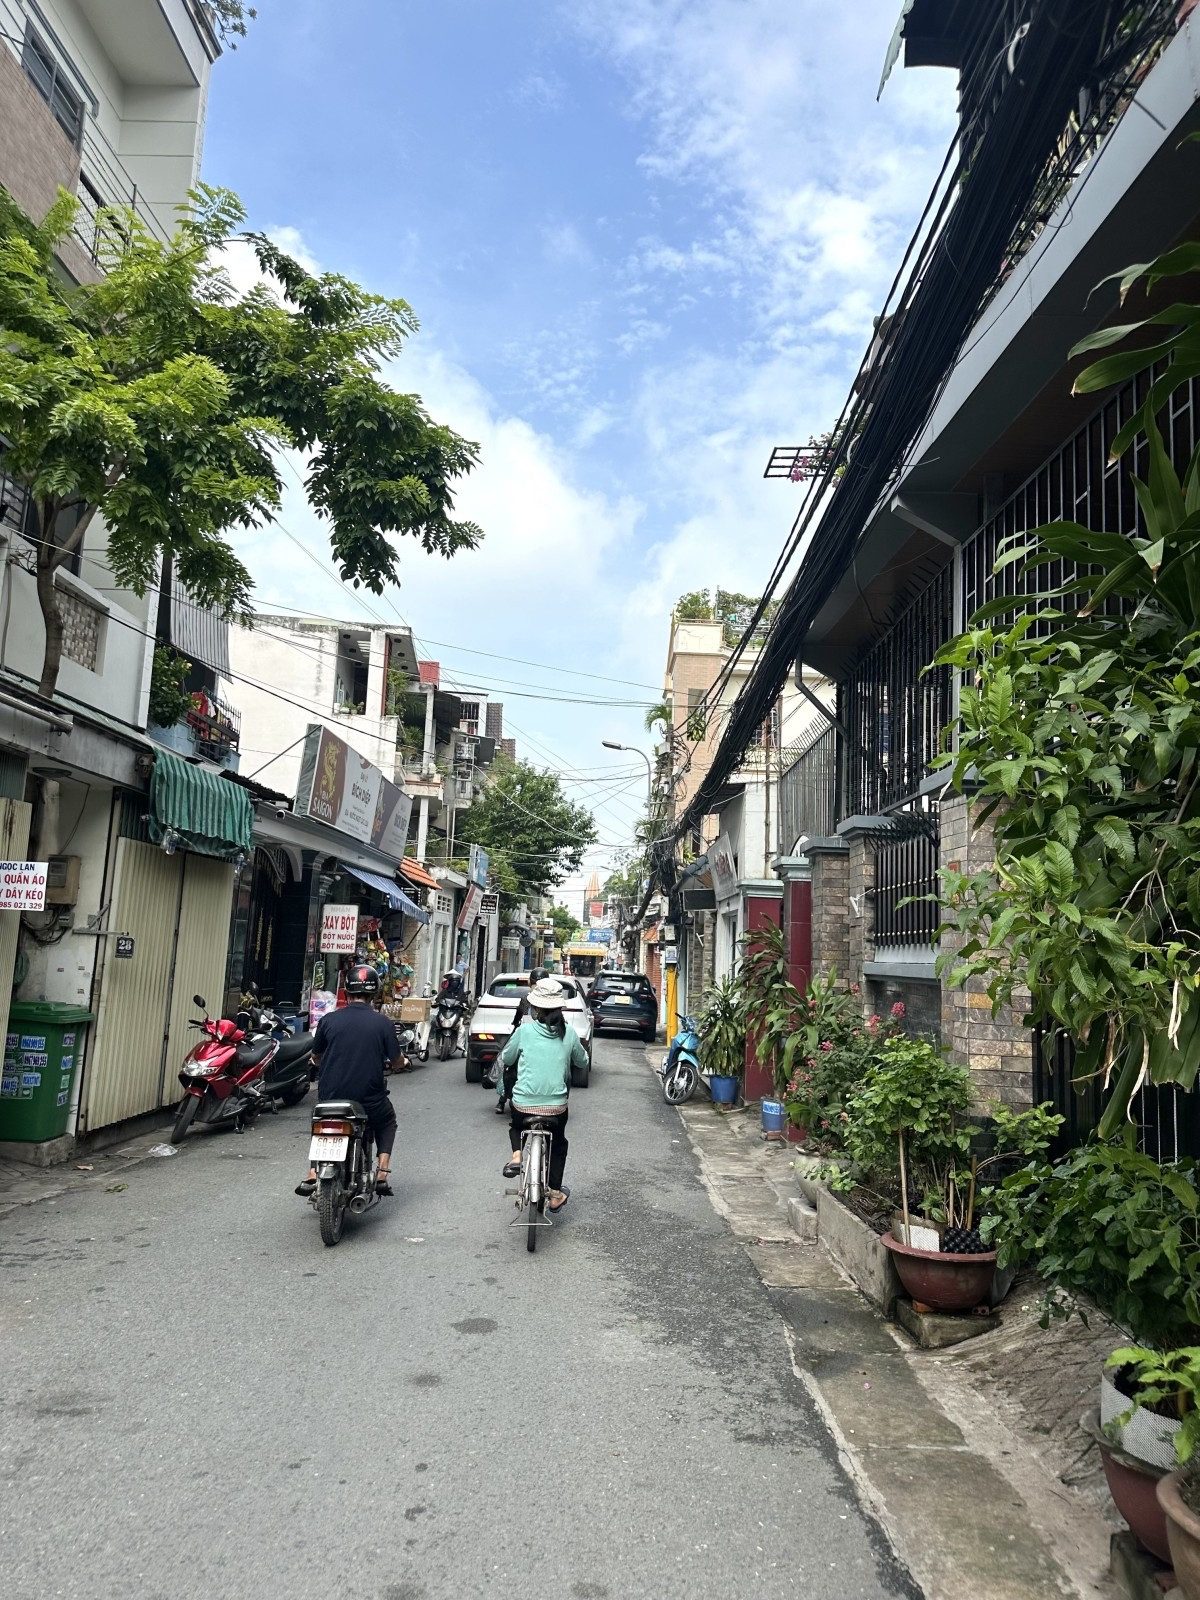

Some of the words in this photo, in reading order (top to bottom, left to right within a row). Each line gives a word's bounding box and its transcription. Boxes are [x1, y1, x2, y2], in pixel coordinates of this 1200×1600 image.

[312, 796, 333, 819] SAIGON
[4, 872, 29, 885] QUẦN
[32, 873, 45, 884] ÁO
[6, 887, 23, 898] DÂY
[26, 888, 43, 900] KÉO
[324, 915, 340, 929] XAY
[119, 940, 132, 950] 28
